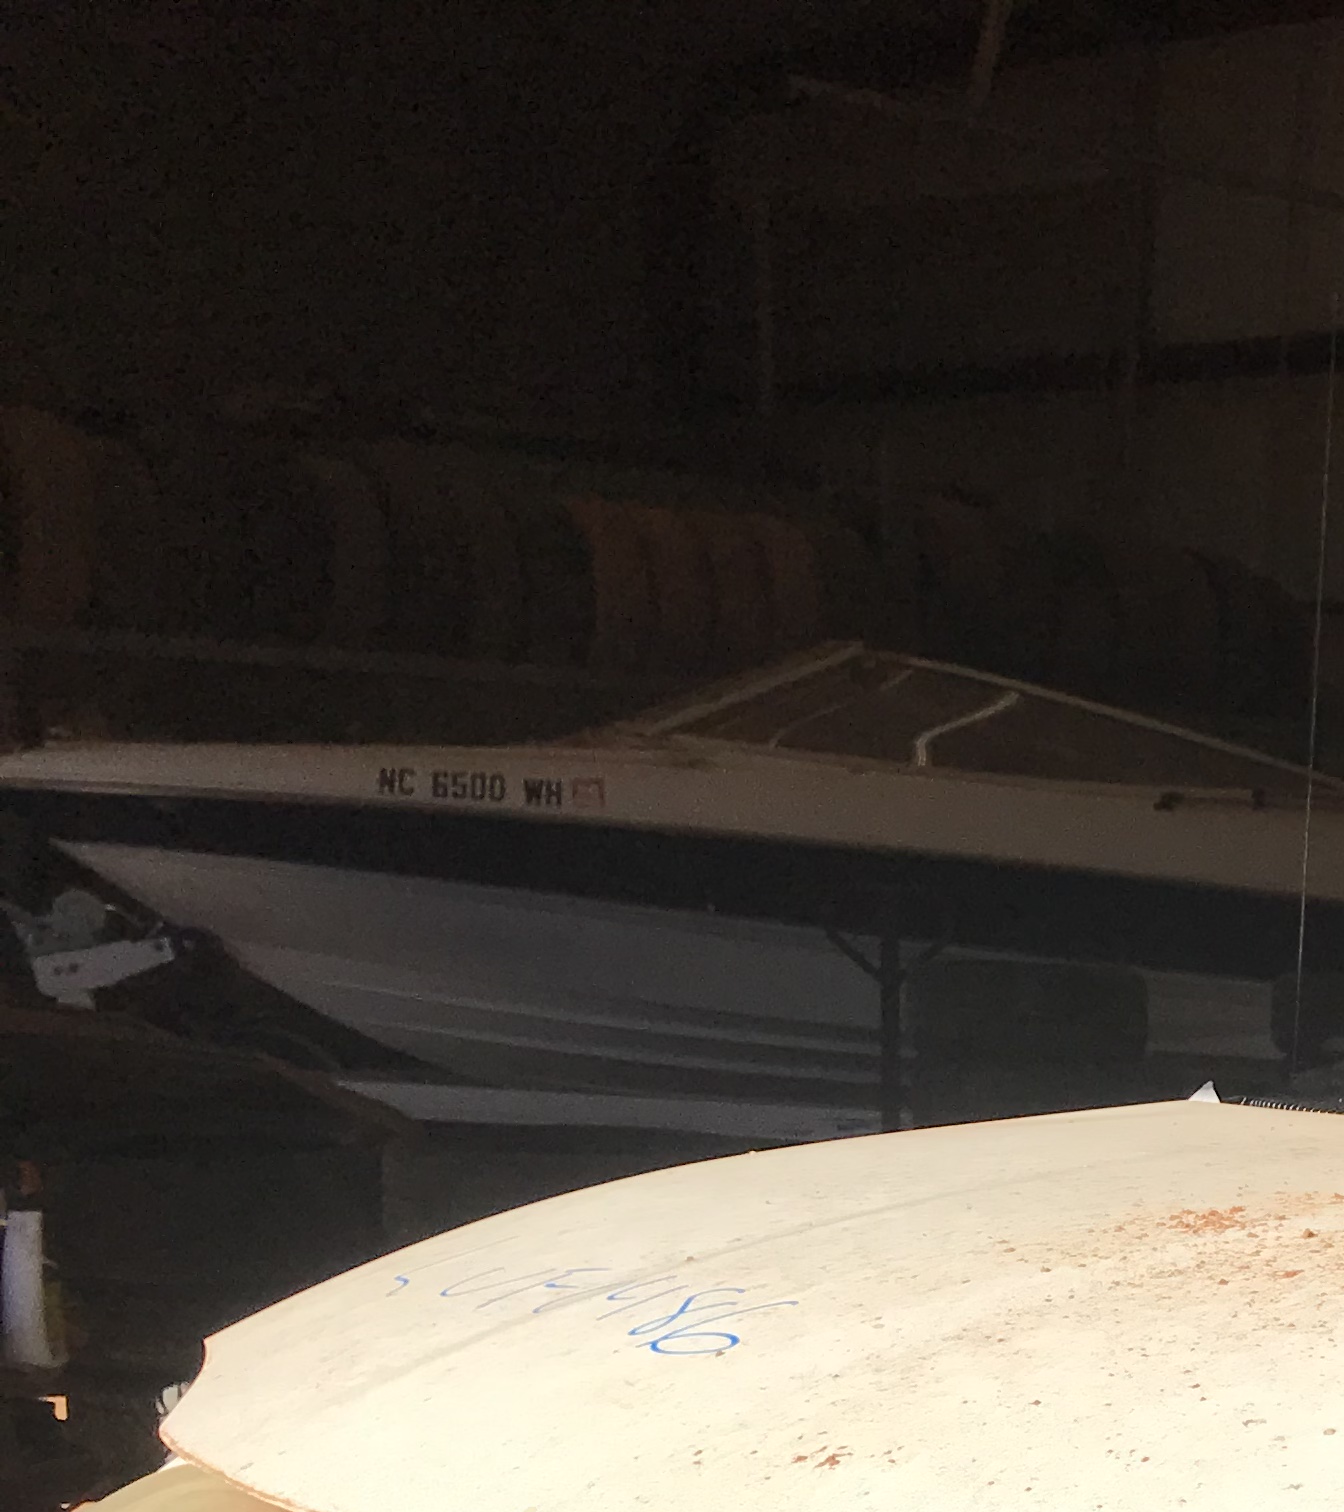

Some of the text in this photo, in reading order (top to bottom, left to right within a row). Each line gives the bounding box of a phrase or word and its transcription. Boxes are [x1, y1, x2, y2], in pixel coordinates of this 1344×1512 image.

[377, 767, 563, 806] NC 6500 WH
